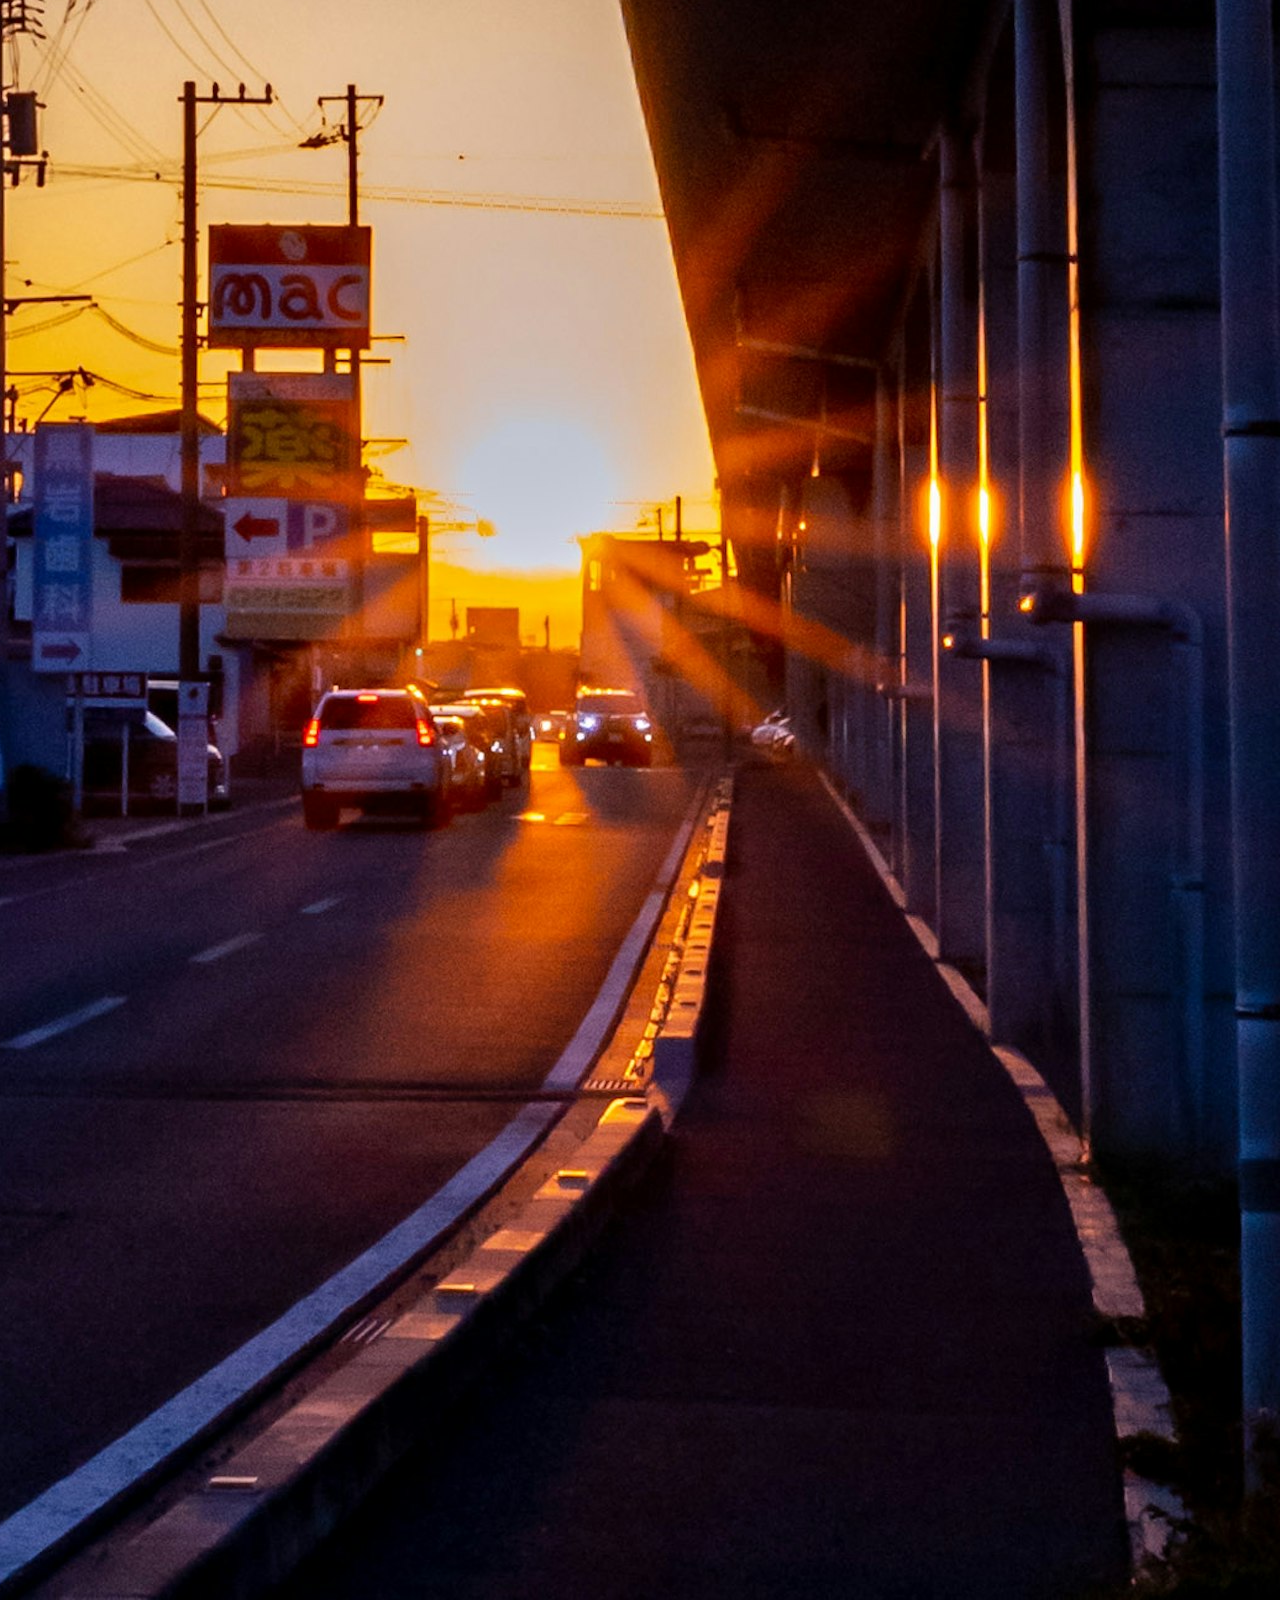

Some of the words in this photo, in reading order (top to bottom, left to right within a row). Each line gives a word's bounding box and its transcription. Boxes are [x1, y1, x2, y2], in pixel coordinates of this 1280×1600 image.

[213, 273, 362, 320] mac
[240, 406, 350, 490] 薬
[304, 504, 337, 550] P
